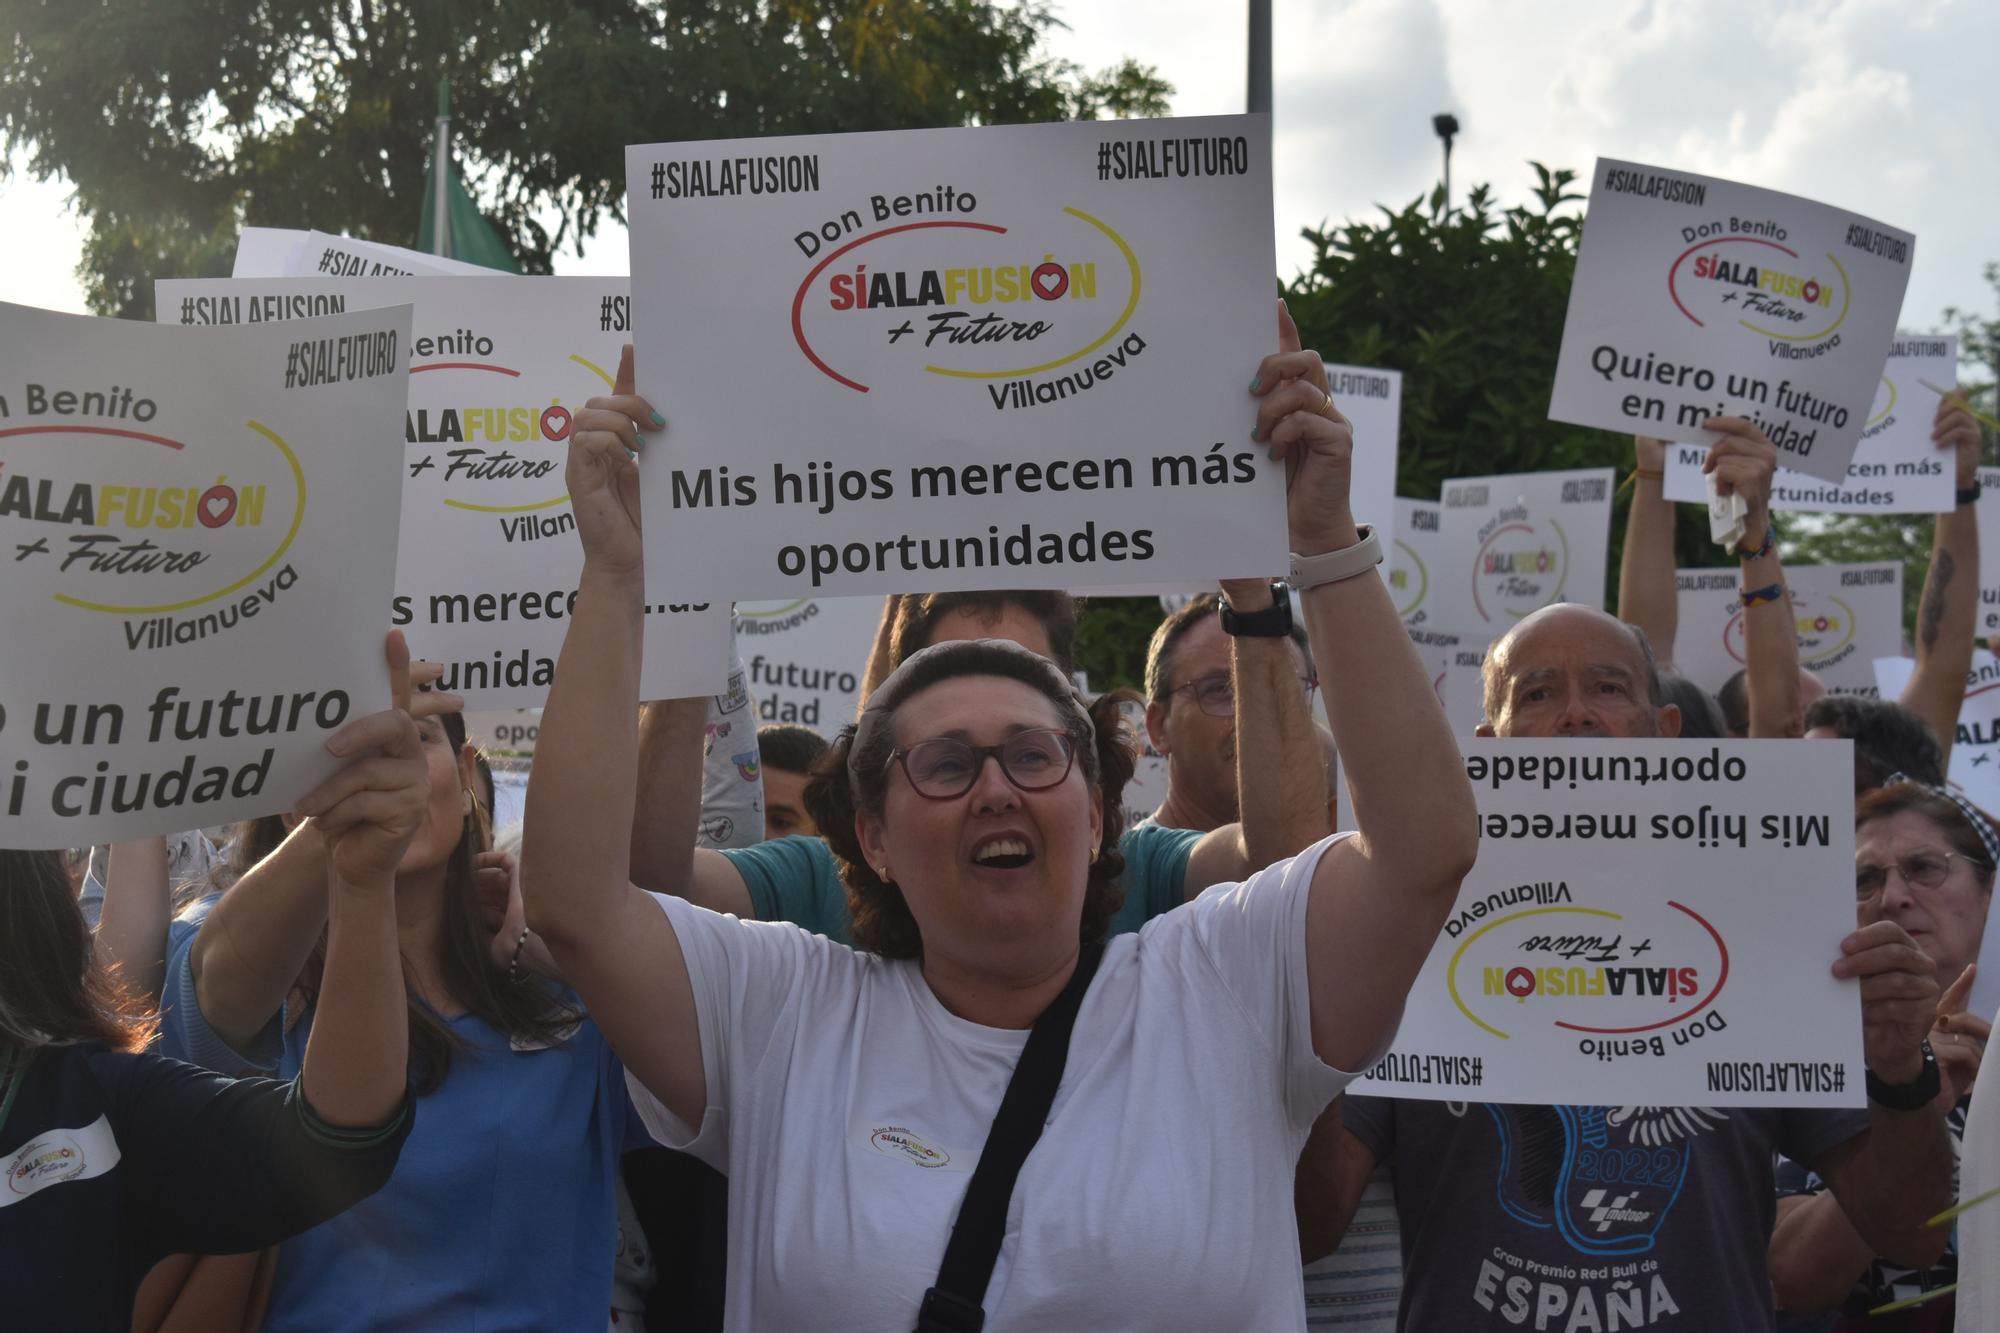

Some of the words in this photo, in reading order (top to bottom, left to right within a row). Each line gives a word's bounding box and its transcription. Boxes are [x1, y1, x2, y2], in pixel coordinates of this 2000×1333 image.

[651, 155, 820, 199] #SIALAFUSION
[1098, 137, 1248, 180] #SIALFUTURO
[1605, 168, 1706, 207] #SIALAFUSION
[794, 211, 862, 258] Don
[870, 185, 977, 222] Benito
[1682, 222, 1723, 243] Don
[1729, 217, 1788, 241] Benito
[1845, 223, 1907, 264] #SIALFUTURO
[1742, 291, 1808, 322] Futuro
[409, 329, 494, 357] enito
[925, 311, 1054, 347] Futuro
[1768, 333, 1842, 361] Villanueva
[285, 329, 397, 389] #SIALFUTURO
[988, 332, 1148, 410] Villanueva
[26, 383, 158, 422] Benito
[1590, 344, 1716, 393] Quiero
[1726, 374, 1769, 404] un
[1775, 378, 1849, 430] futuro
[1621, 392, 1666, 423] en
[1740, 409, 1818, 457] iudad
[444, 448, 559, 482] Futuro
[670, 465, 758, 509] Mis
[773, 460, 895, 515] hijos
[910, 455, 1134, 498] merecen
[1150, 443, 1257, 487] más
[1894, 457, 1942, 477] más
[60, 534, 212, 574] Futuro
[776, 520, 1155, 588] oportunidades
[124, 564, 299, 650] Villanueva
[750, 654, 857, 694] futuro
[33, 702, 125, 745] un
[147, 686, 351, 743] futuro
[51, 747, 275, 817] ciudad
[1462, 747, 1746, 790] oportunidade
[1651, 805, 1747, 849] hijos
[1761, 813, 1830, 848] Mis
[1443, 880, 1572, 940] Villanueva
[1520, 935, 1622, 962] Futuro
[1580, 1036, 1665, 1062] Benito
[1672, 1009, 1727, 1048] Don
[1706, 1061, 1846, 1093] #SIALAFUSION
[1576, 1147, 1682, 1188] 2022
[1493, 1246, 1523, 1269] Gran
[1526, 1259, 1577, 1280] Premio
[1580, 1264, 1608, 1280] Red
[1611, 1262, 1638, 1278] Bull
[1641, 1259, 1659, 1273] de
[1473, 1259, 1681, 1333] ESPAÑA
